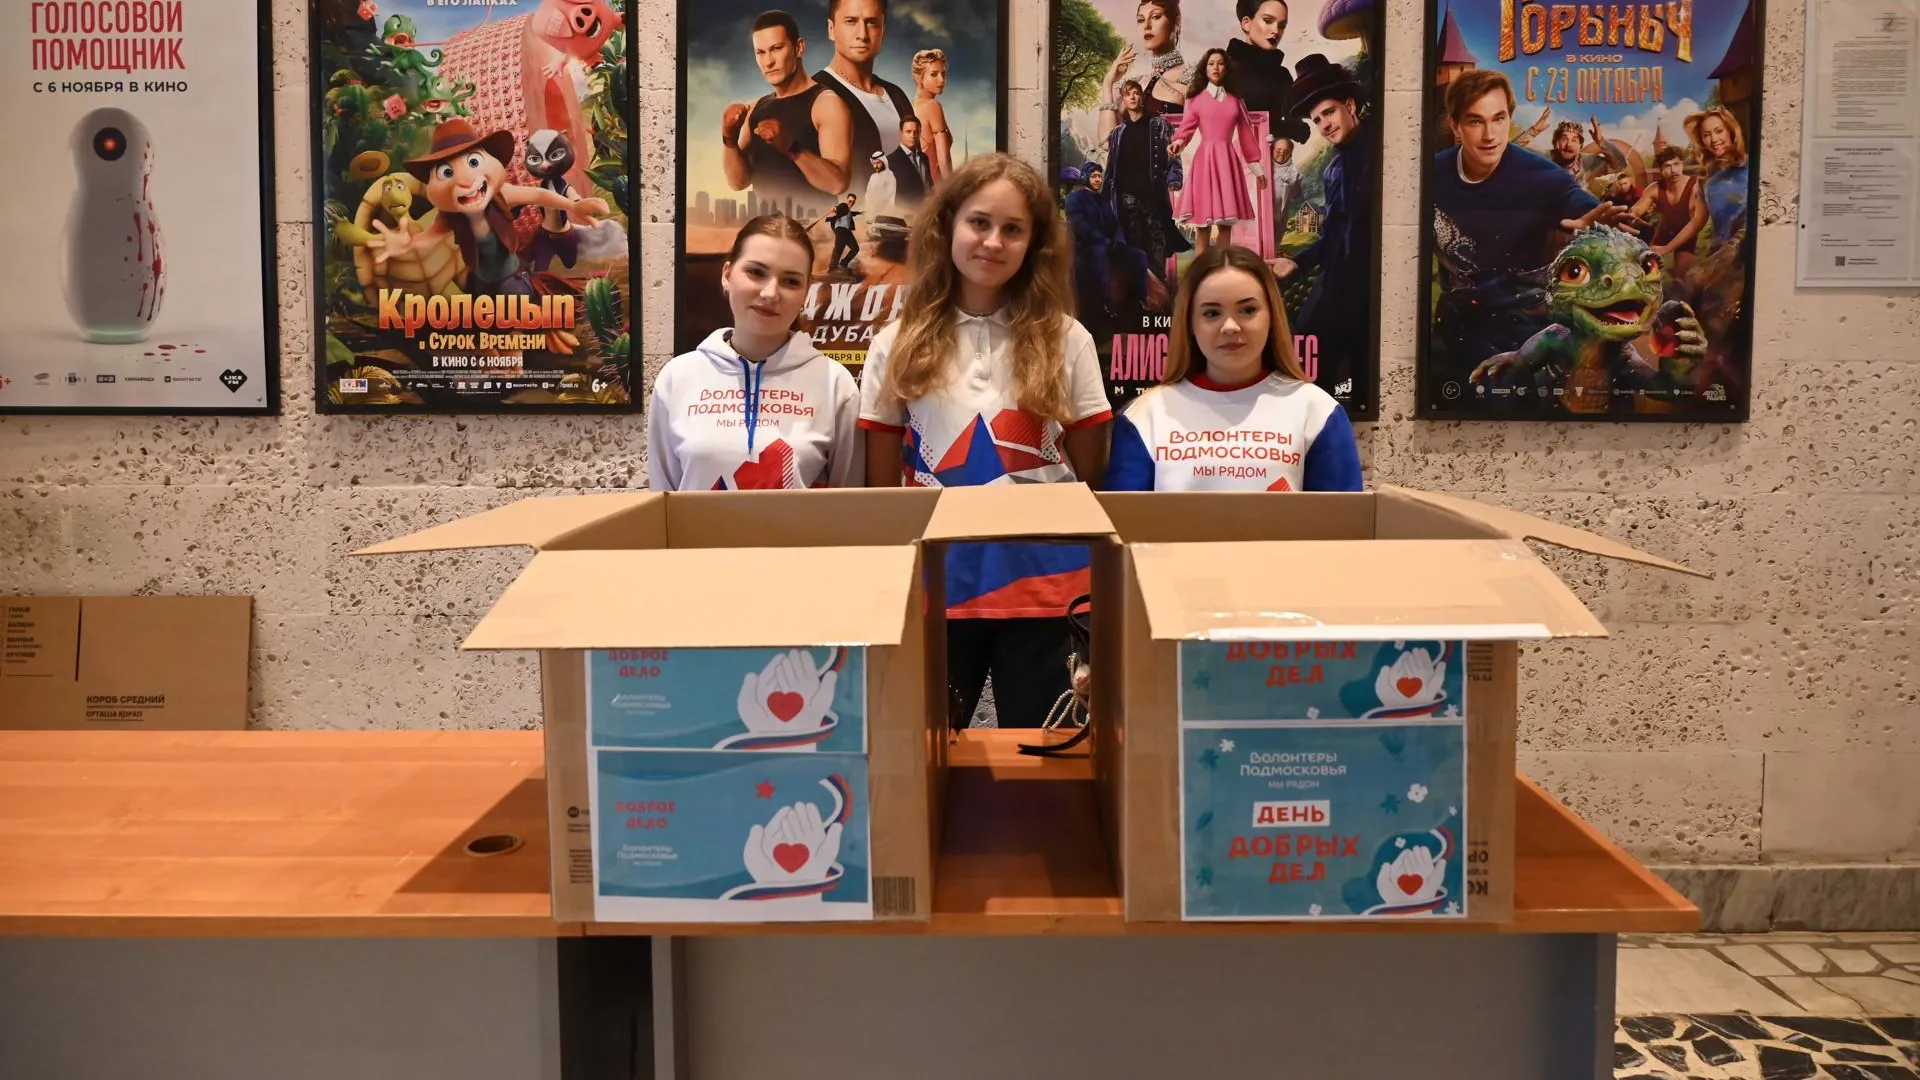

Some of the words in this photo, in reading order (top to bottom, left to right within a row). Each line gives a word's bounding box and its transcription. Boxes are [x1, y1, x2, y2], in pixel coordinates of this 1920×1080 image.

[32, 38, 186, 74] ПОМОЩНИК
[1565, 54, 1575, 62] В
[1579, 54, 1623, 63] КИНО
[33, 82, 43, 93] С
[48, 81, 57, 93] 6
[62, 82, 123, 93] НОЯБРЯ
[129, 82, 139, 92] В
[144, 81, 188, 92] КИНО
[1526, 65, 1539, 102] С
[1547, 67, 1568, 103] 23
[378, 288, 576, 338] Кролецып
[1142, 315, 1150, 328] В
[432, 356, 439, 367] В
[441, 356, 468, 367] КИНО
[470, 356, 477, 367] С
[478, 356, 485, 367] 6
[487, 356, 524, 367] НОЯБРЯ
[854, 353, 862, 361] В
[591, 378, 608, 393] 6+
[716, 418, 736, 428] МЫ
[1193, 466, 1215, 477] МЫ
[1219, 466, 1267, 479] РЯДОМ
[618, 665, 662, 679] ДЕЛО
[1265, 664, 1325, 687] ДЕЛ
[86, 695, 118, 704] КОРОБ
[119, 694, 165, 705] СРЕДНИЙ
[614, 800, 677, 814] ДОБРОЕ
[1257, 804, 1325, 824] ДЕНЬ
[625, 816, 669, 830] ДЕЛО
[1228, 834, 1361, 859] ДОБРЫХ
[1268, 861, 1327, 884] ДЕЛ
